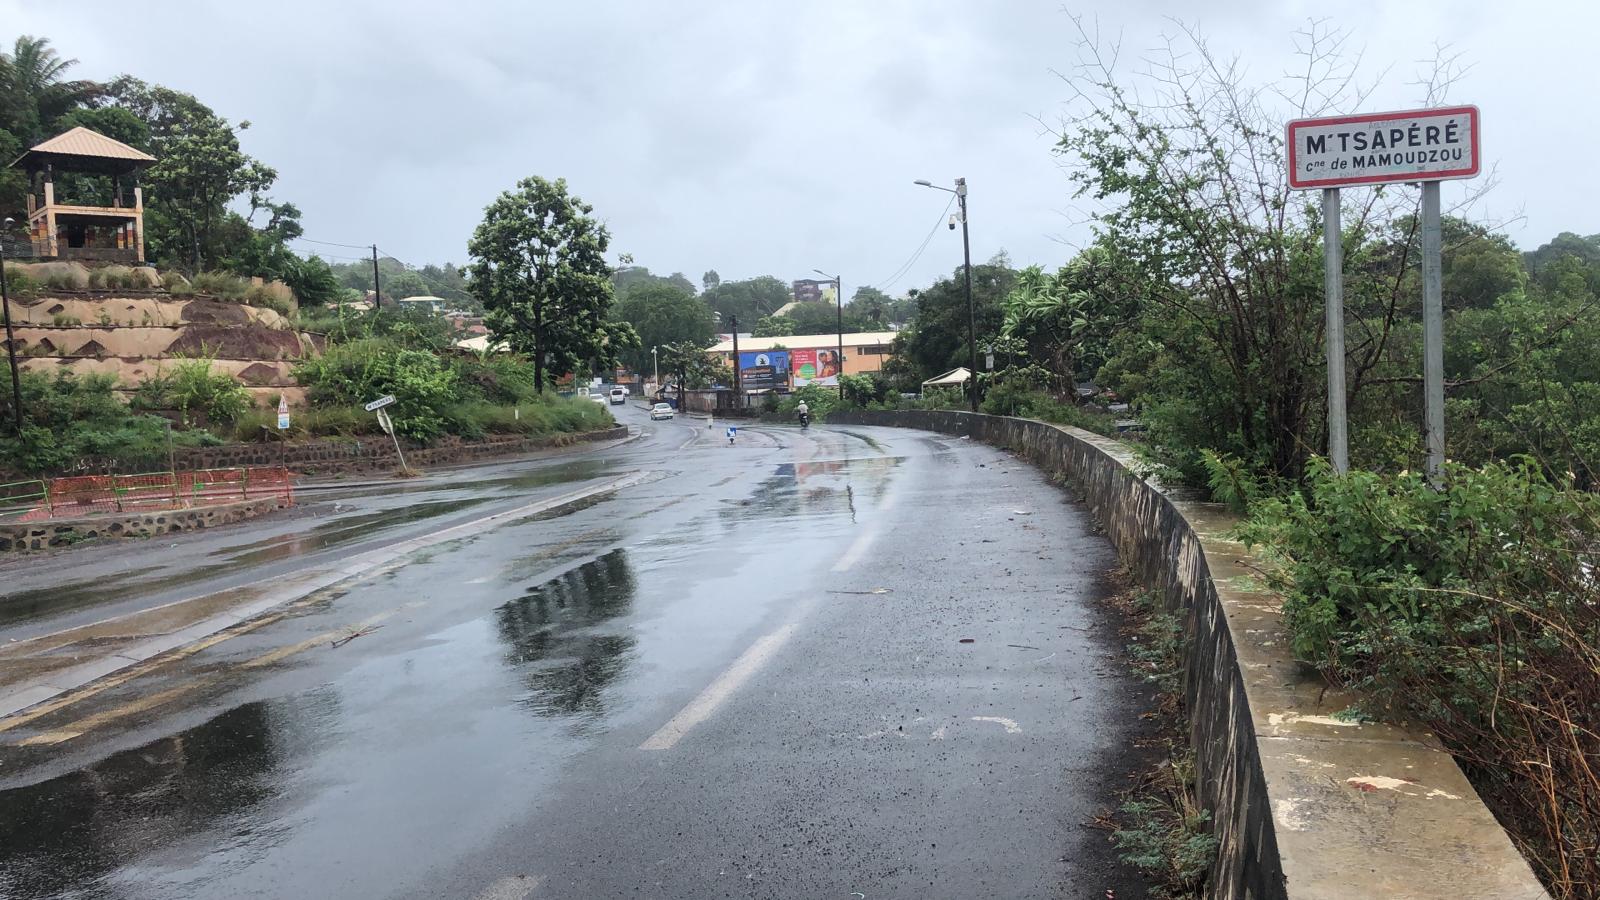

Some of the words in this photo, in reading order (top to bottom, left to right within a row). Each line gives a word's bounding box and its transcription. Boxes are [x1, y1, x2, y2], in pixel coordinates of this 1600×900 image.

[1307, 120, 1459, 155] M'TSAPÉRÉ
[1331, 157, 1347, 170] de
[1353, 148, 1462, 169] MAMOUDZOU
